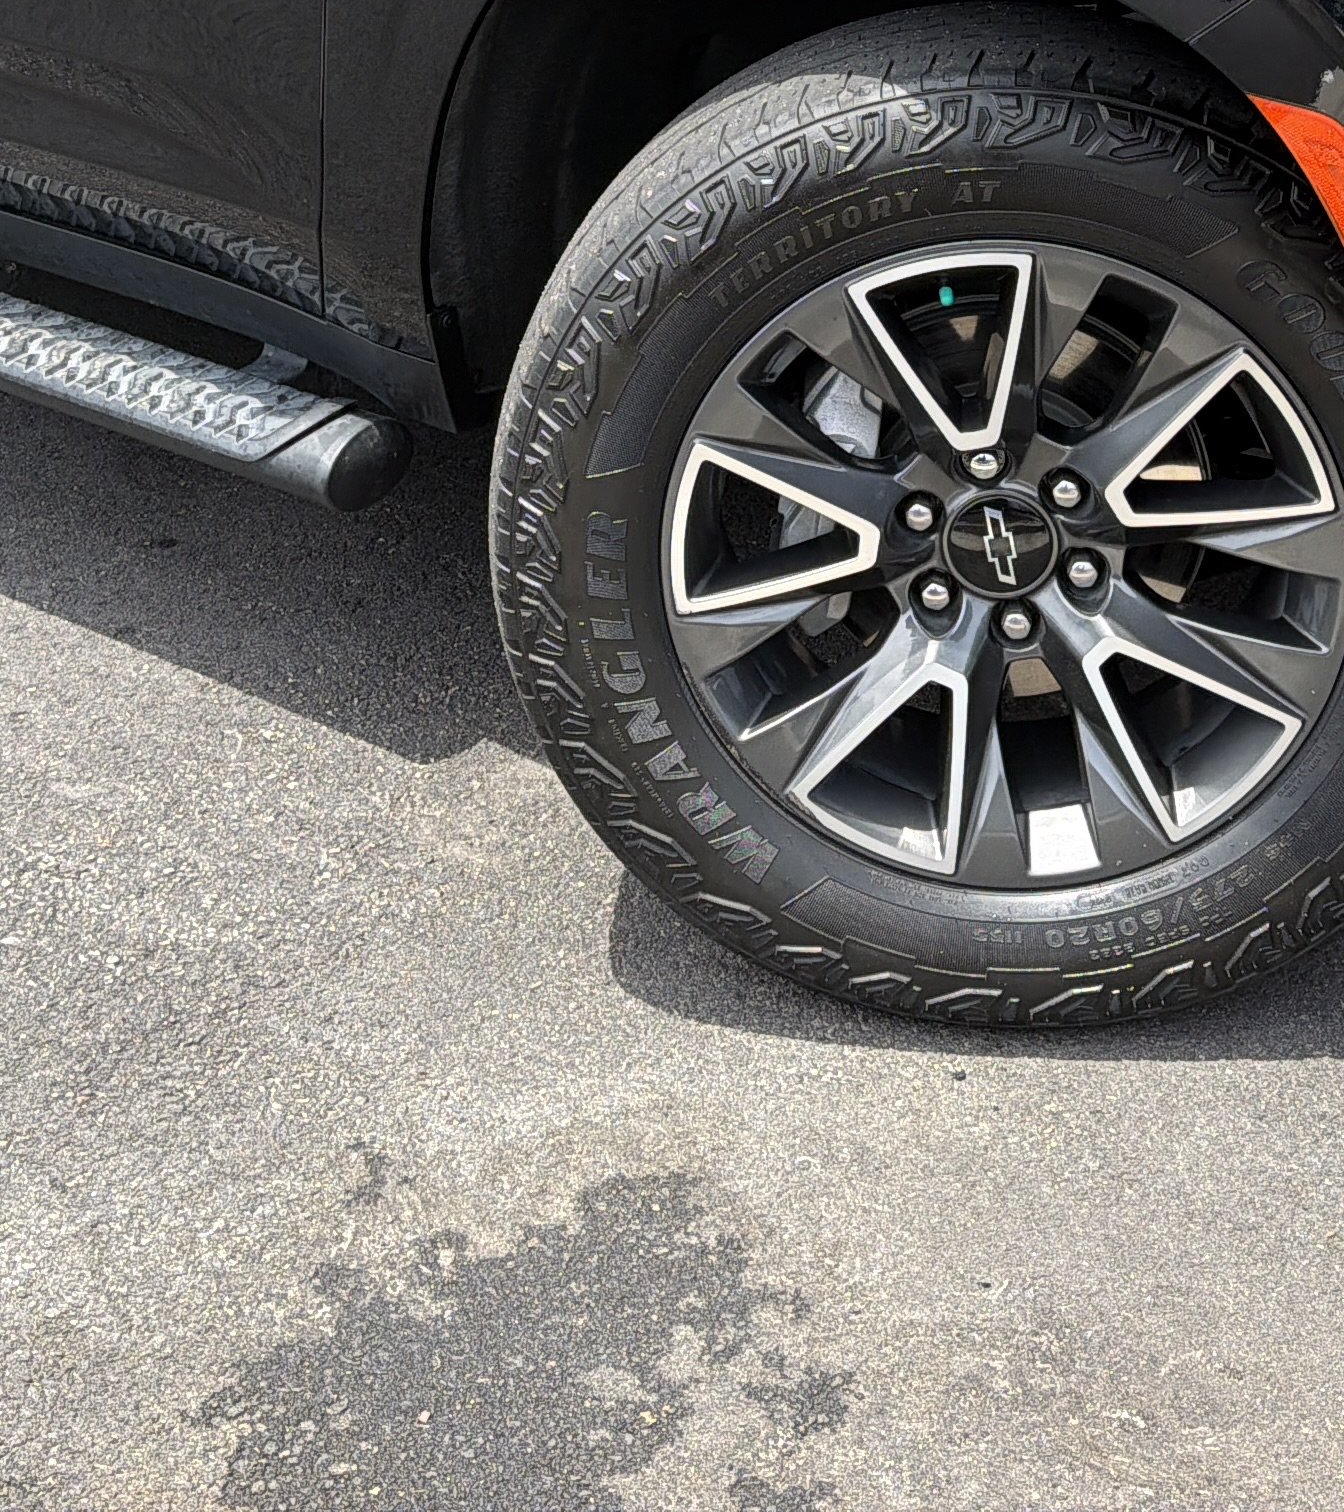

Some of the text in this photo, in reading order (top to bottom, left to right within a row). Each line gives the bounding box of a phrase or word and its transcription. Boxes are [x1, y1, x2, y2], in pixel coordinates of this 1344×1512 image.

[710, 187, 919, 308] TERRITORY
[952, 181, 1002, 205] AT
[586, 511, 780, 885] WRANGLER
[1044, 862, 1253, 950] 275/60R20
